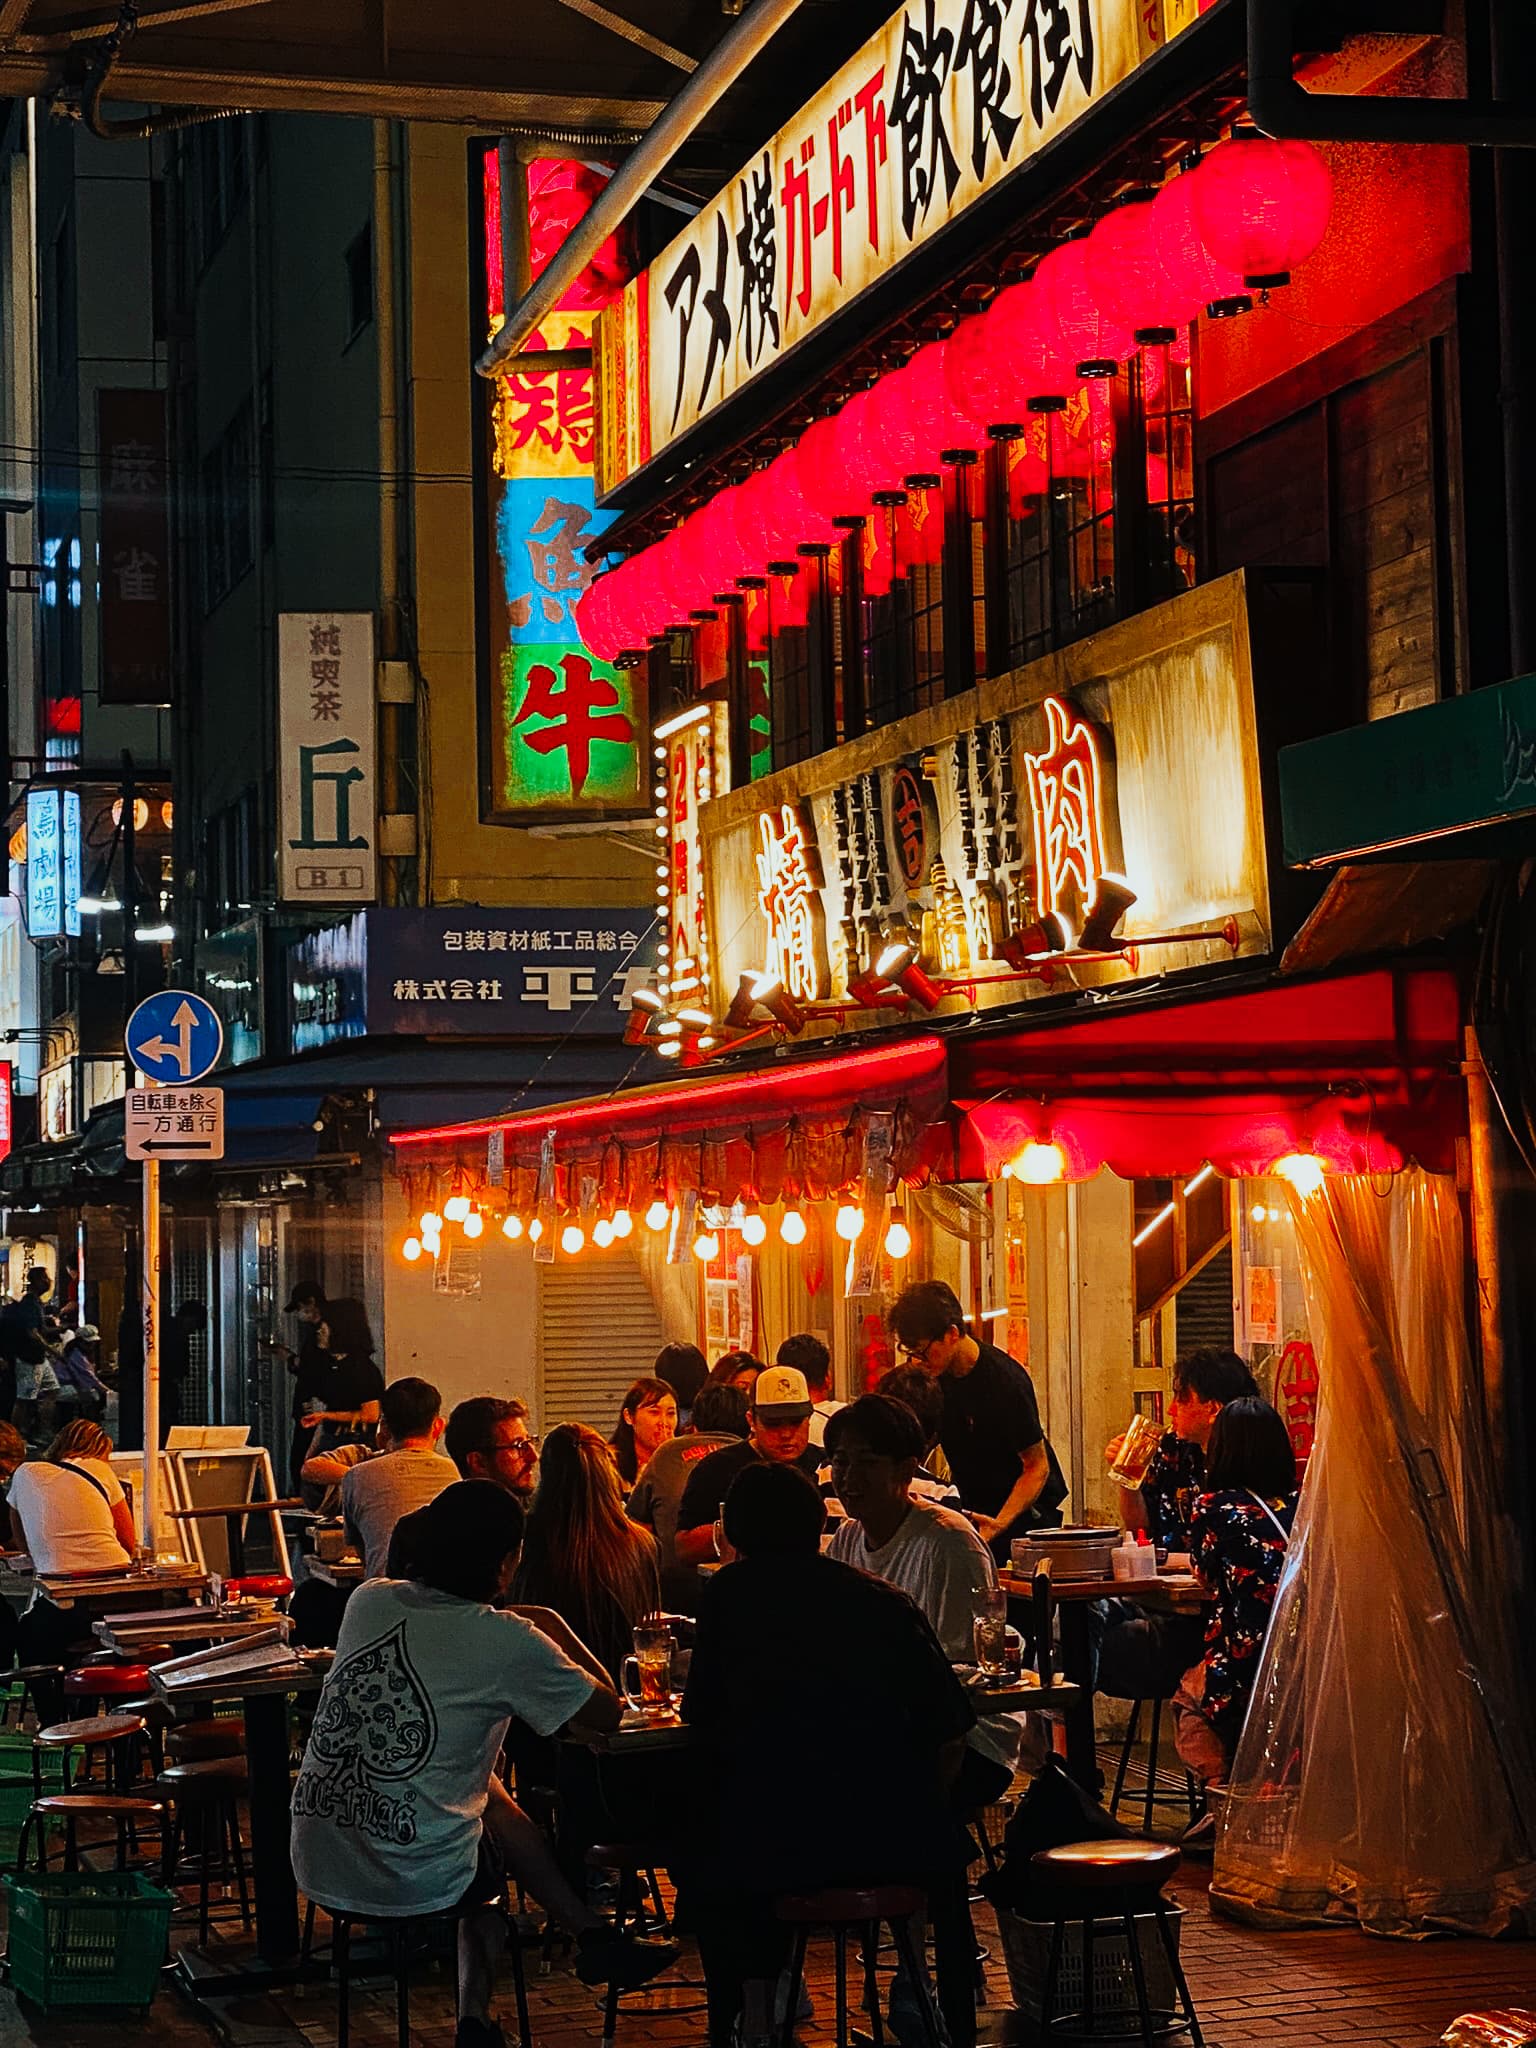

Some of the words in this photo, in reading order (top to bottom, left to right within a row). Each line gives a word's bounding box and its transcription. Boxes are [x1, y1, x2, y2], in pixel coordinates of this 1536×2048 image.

[309, 624, 342, 721] 純喫茶
[288, 737, 369, 850] 丘
[1023, 696, 1106, 918] 肉
[442, 930, 639, 951] 包装資材紙工品総合
[393, 979, 503, 1001] 株式会社
[131, 1094, 216, 1111] 自転車を除く
[132, 1115, 218, 1133] 一方通行
